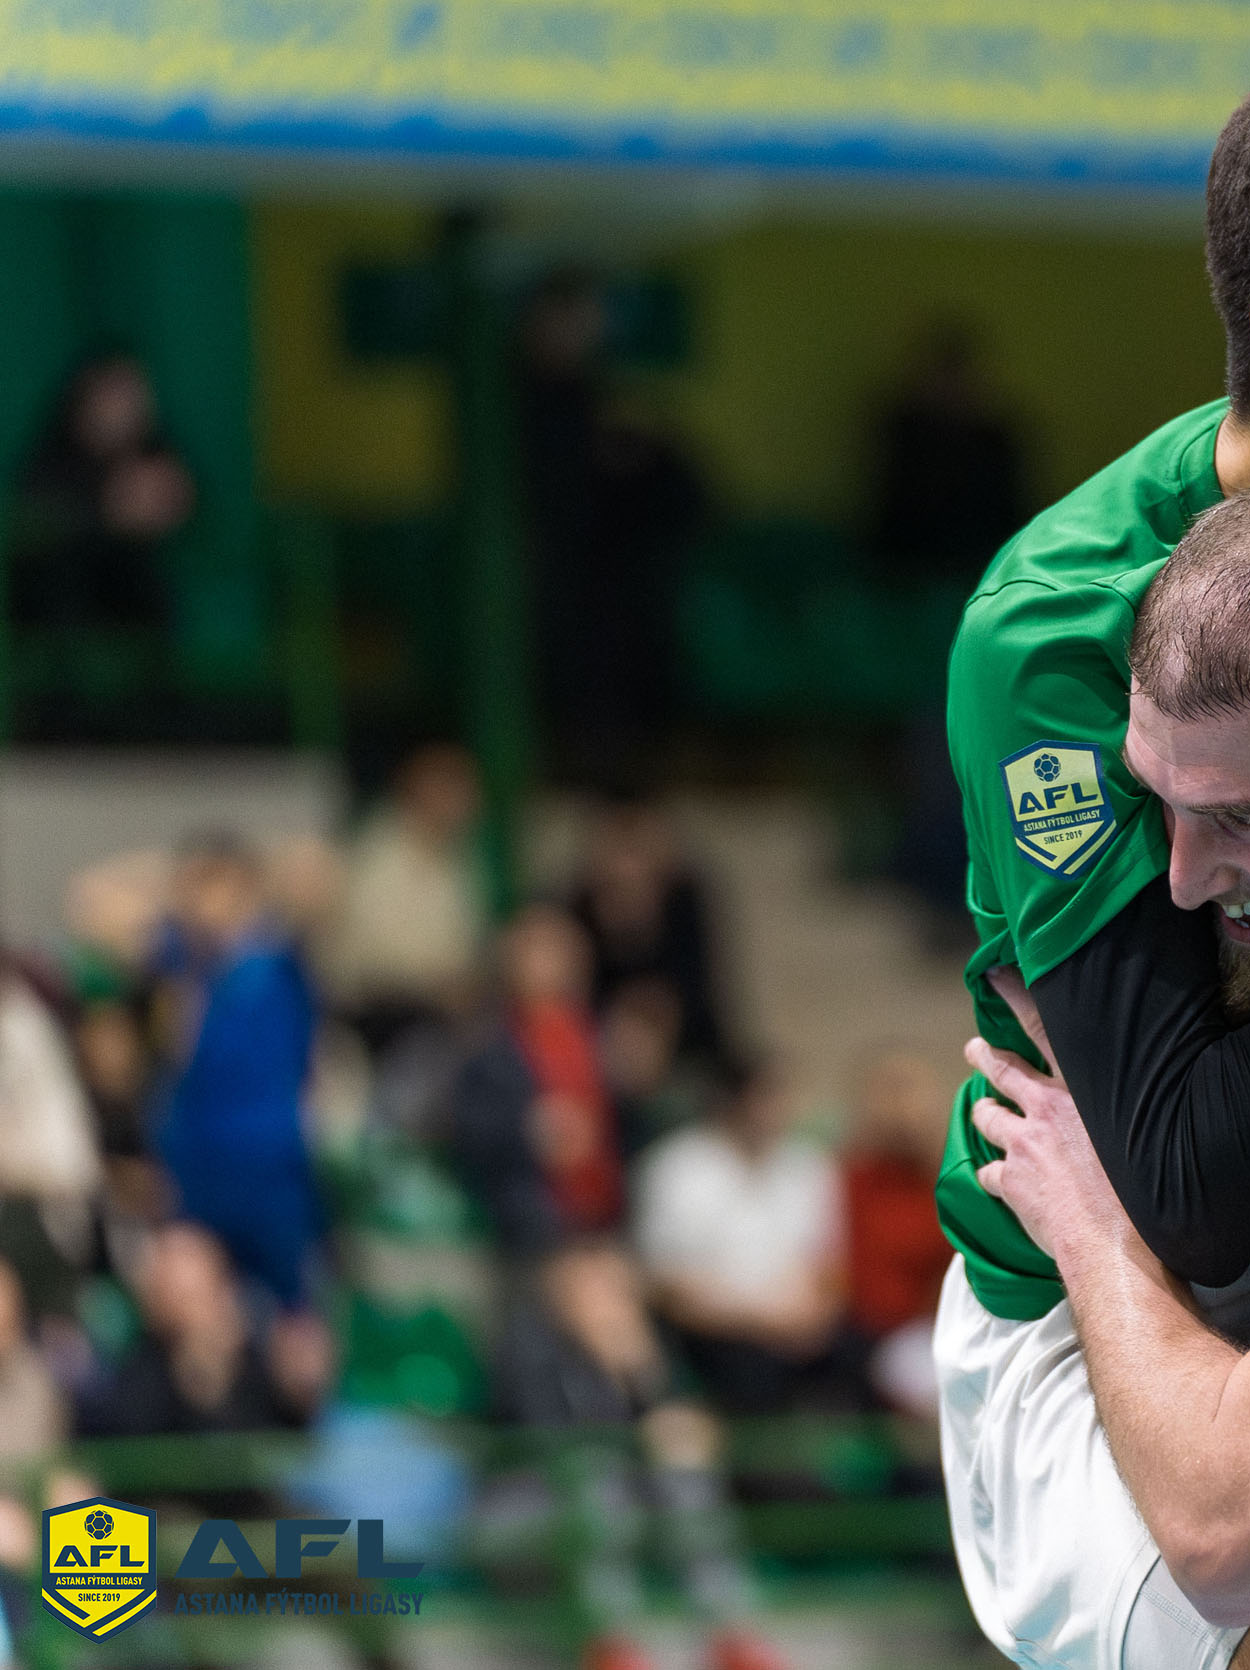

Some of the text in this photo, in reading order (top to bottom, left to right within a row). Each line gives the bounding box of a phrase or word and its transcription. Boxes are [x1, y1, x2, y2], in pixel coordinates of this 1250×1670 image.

[1018, 782, 1098, 815] AFL
[1023, 819, 1047, 832] ASTANA
[1075, 809, 1101, 823] LIGASY
[1043, 830, 1083, 845] SINCE 2019
